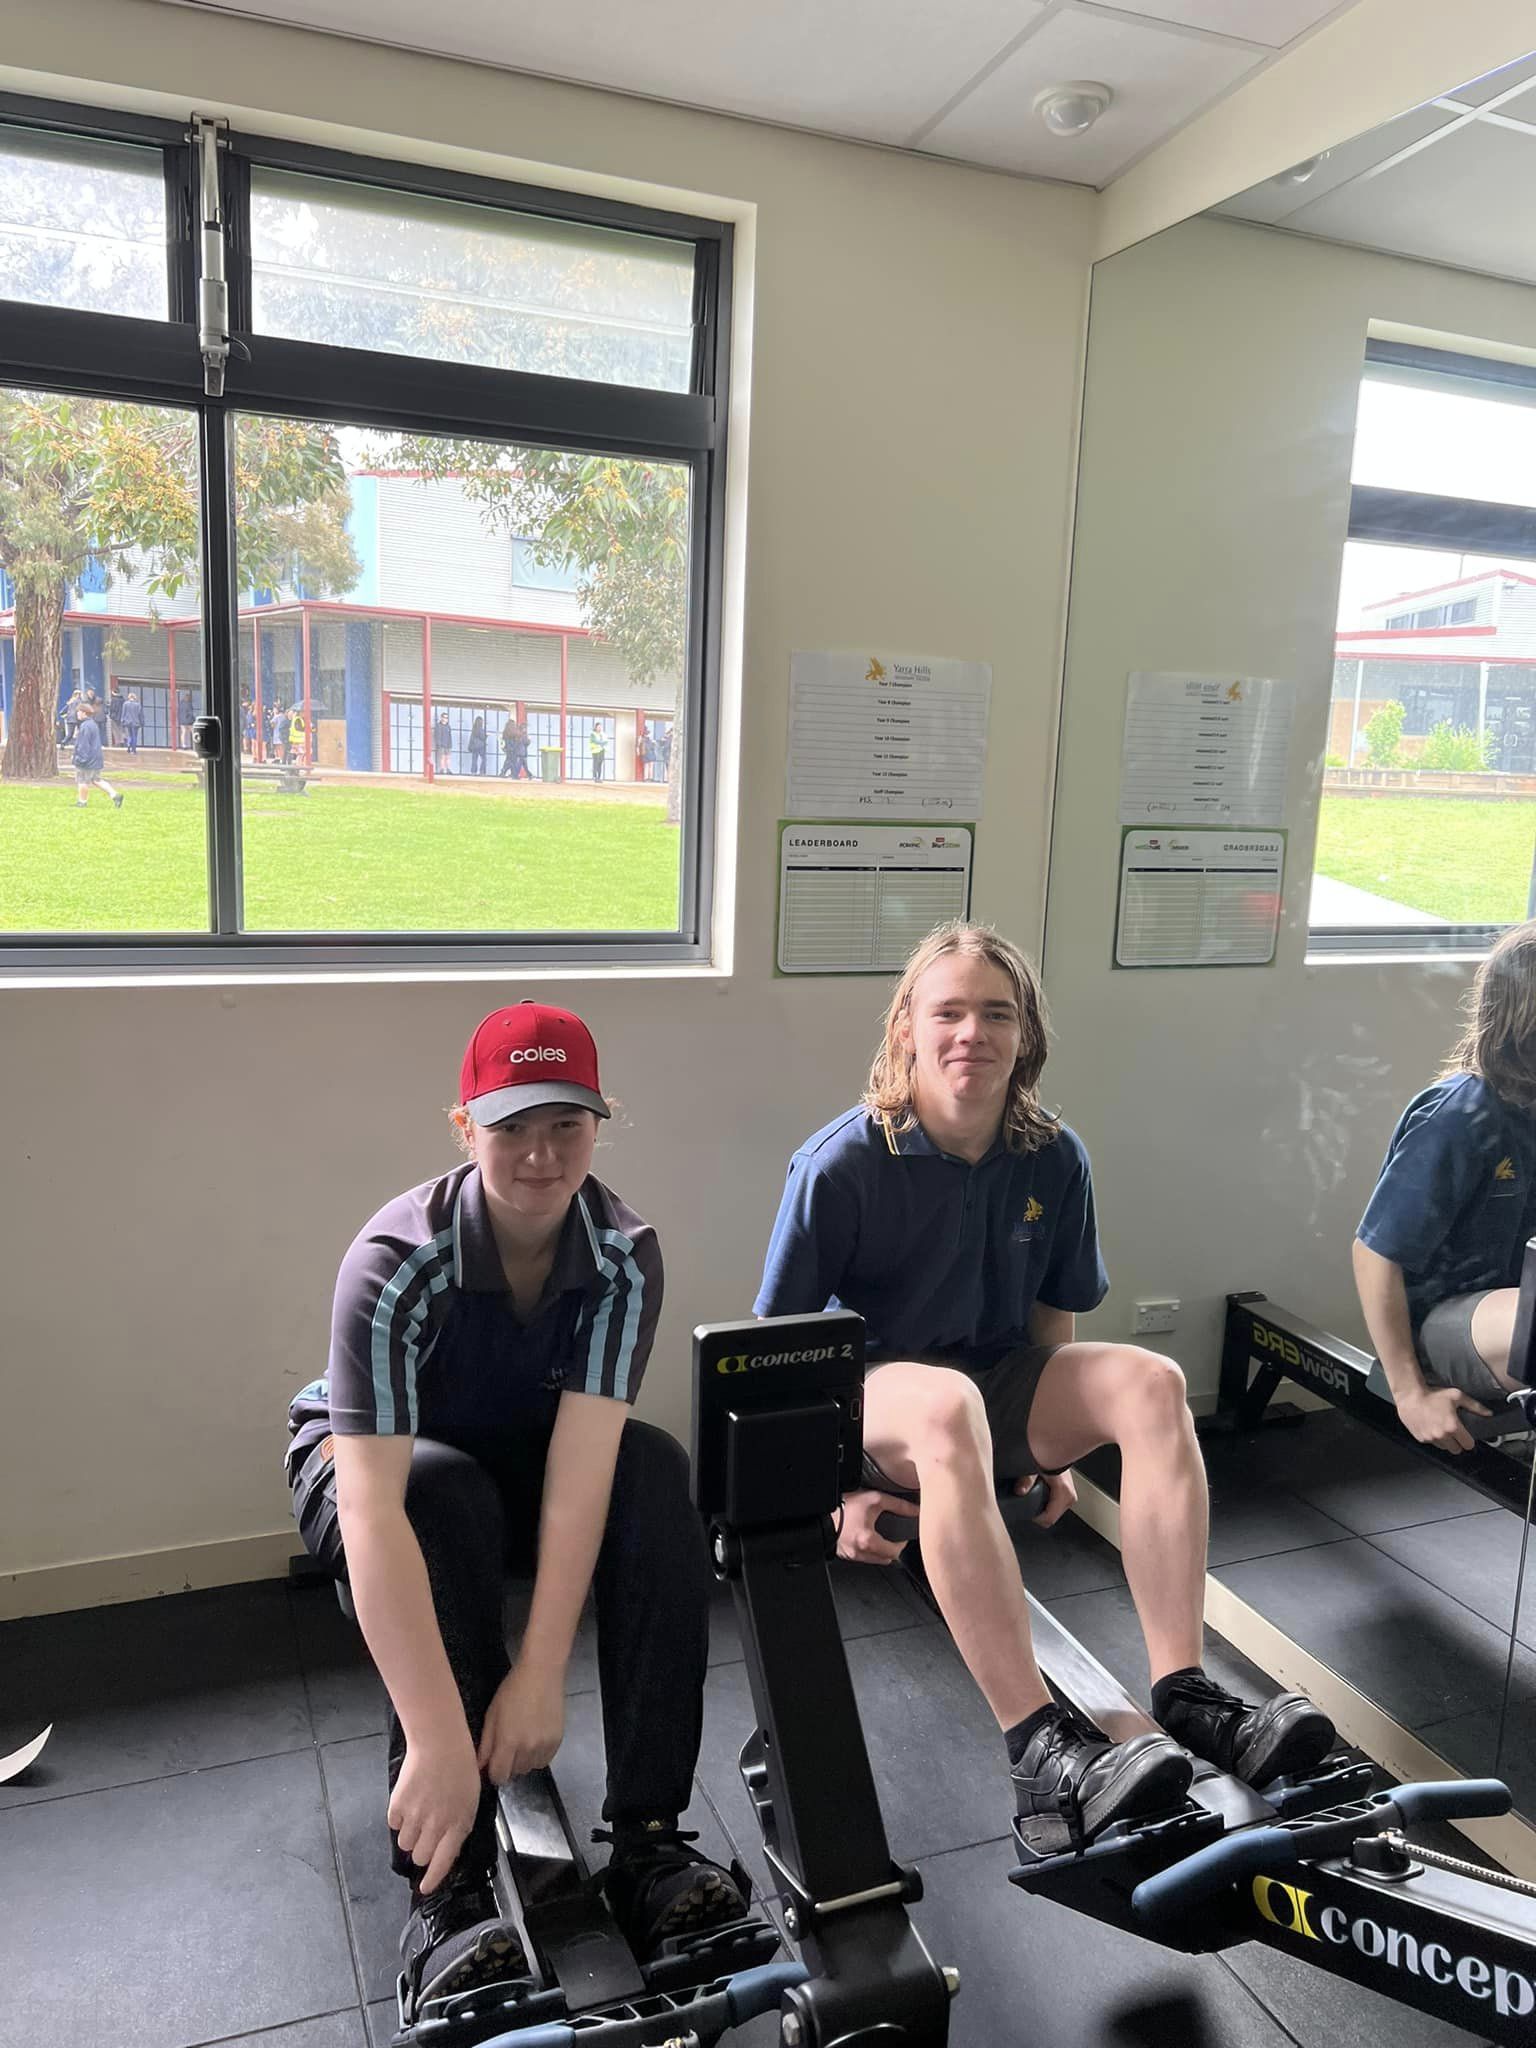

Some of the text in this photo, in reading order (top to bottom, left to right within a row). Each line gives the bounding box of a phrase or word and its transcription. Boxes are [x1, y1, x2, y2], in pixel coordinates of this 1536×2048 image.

[789, 839, 859, 848] LEADERBOARD
[510, 1046, 567, 1063] coles
[750, 1343, 853, 1369] concept 2
[1320, 1906, 1536, 2017] concep
